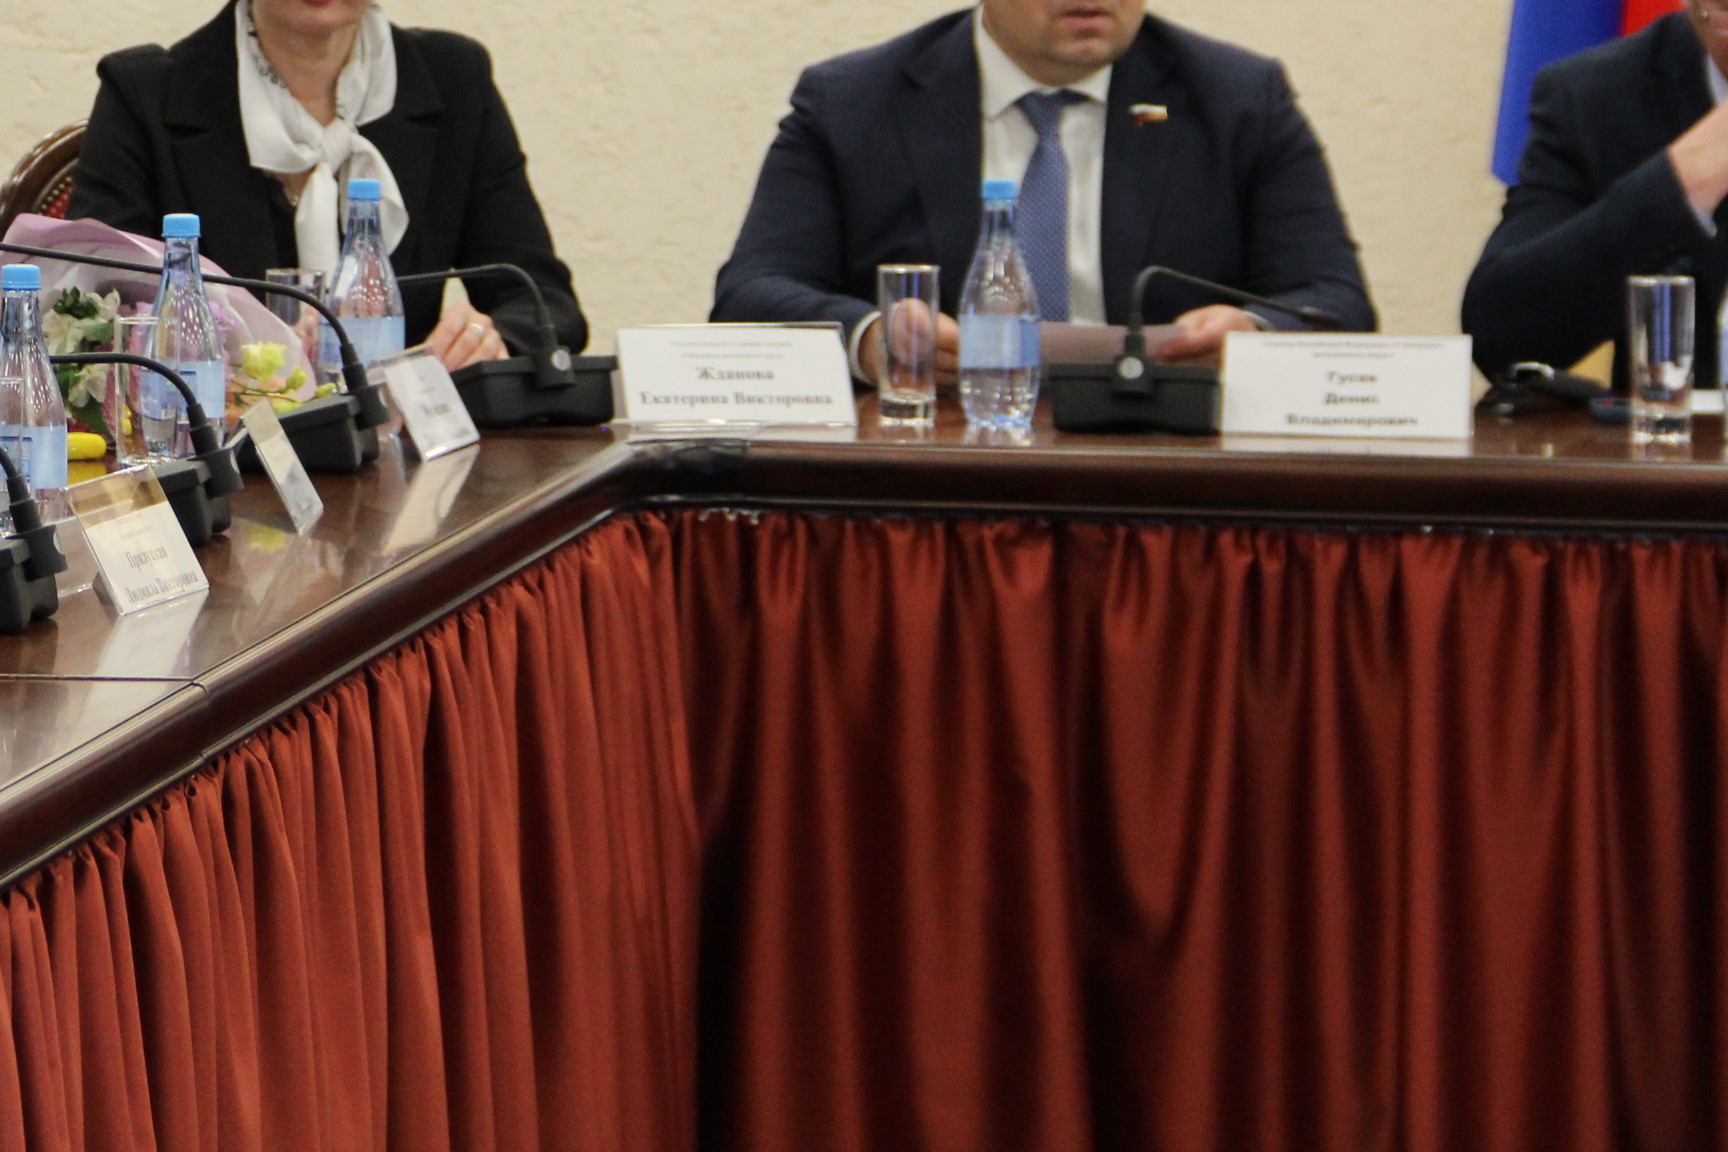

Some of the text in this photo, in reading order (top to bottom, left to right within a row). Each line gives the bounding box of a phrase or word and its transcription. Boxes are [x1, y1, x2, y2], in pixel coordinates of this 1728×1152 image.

[694, 366, 775, 380] Жданова
[640, 392, 834, 408] Екатерина Викторовна
[1325, 392, 1379, 405] Денис
[1286, 413, 1418, 427] Владимирович
